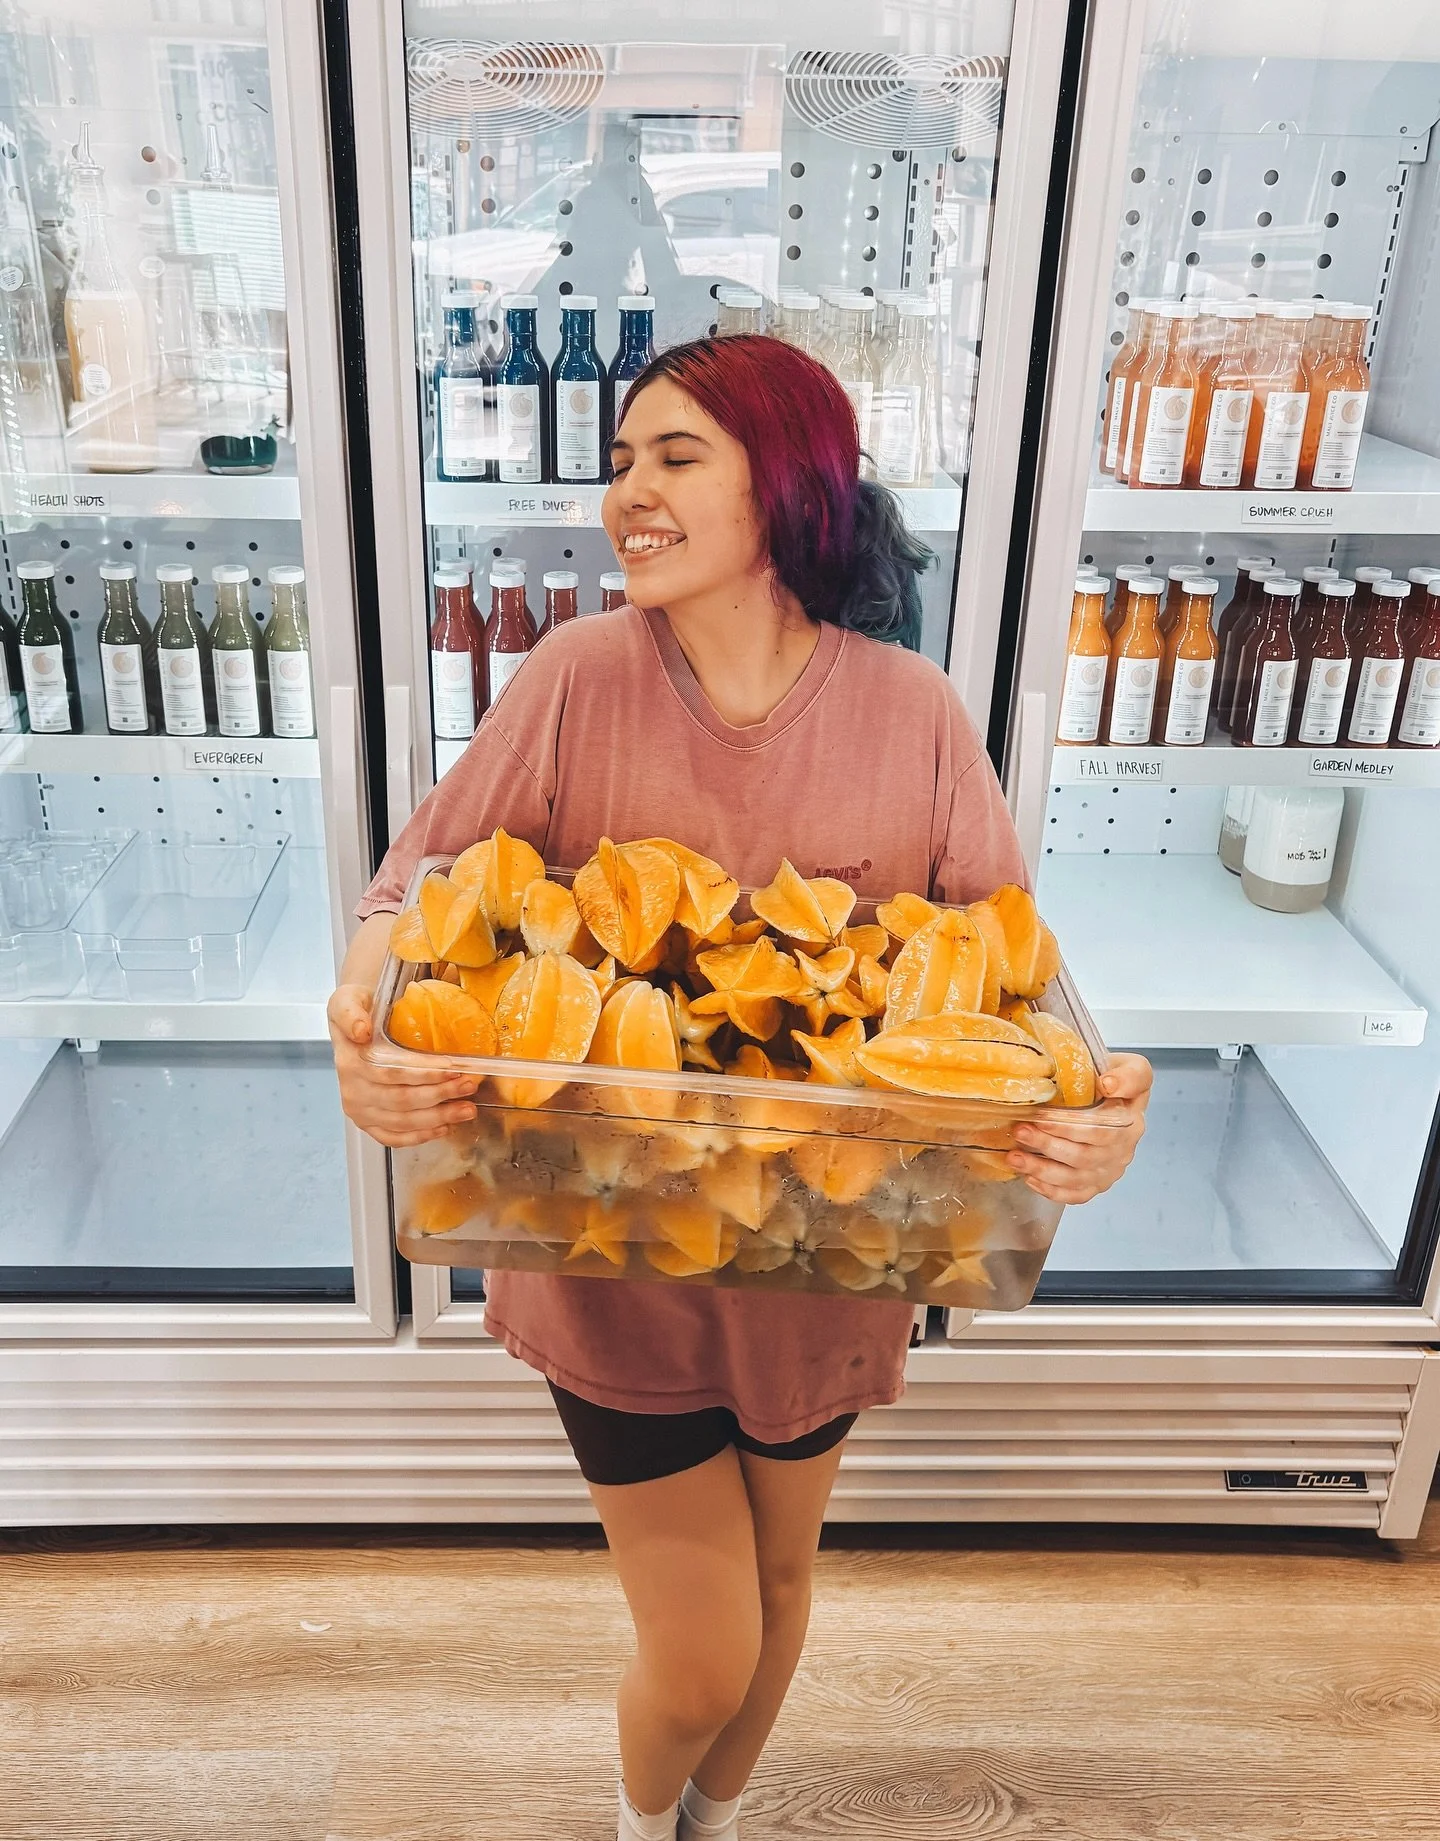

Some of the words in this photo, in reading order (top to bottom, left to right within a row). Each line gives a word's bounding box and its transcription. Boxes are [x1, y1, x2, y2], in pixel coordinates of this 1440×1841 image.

[30, 493, 68, 507] HEALTH
[73, 495, 105, 507] SHOTS
[508, 499, 536, 511] FREE
[542, 500, 576, 512] DIVER
[1249, 506, 1297, 517] SUMMER
[1300, 507, 1333, 518] CRUSH
[194, 751, 263, 765] EVERGREEN
[1080, 759, 1109, 776] FALL
[1116, 761, 1162, 776] HARVEST
[1313, 758, 1353, 773] GARDEN
[1354, 760, 1394, 775] MEDLEY
[1371, 1022, 1393, 1032] MCB
[1285, 1472, 1357, 1487] True
